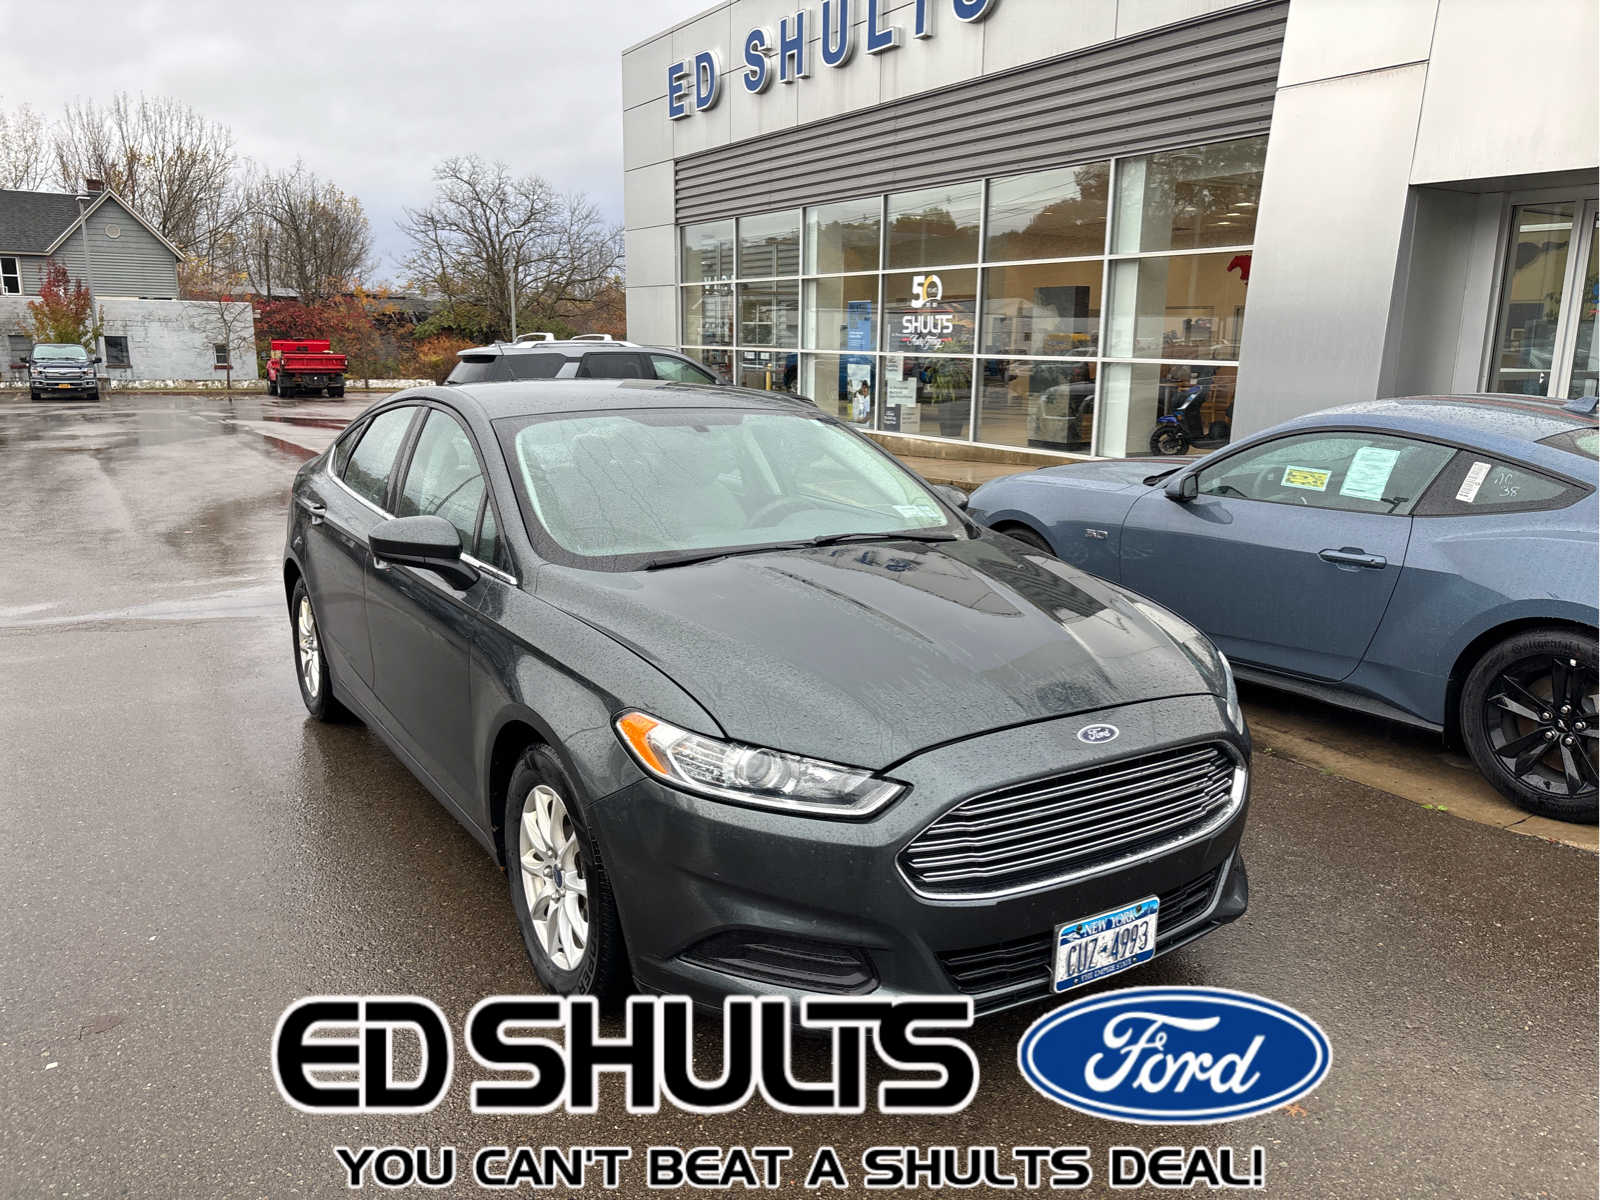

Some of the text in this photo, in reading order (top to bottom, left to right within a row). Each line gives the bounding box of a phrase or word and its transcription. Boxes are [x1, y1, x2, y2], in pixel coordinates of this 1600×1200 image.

[667, 0, 996, 120] ED SHUL
[911, 275, 943, 308] 50
[902, 314, 953, 334] SHULTS
[1083, 911, 1136, 936] NEW YORK
